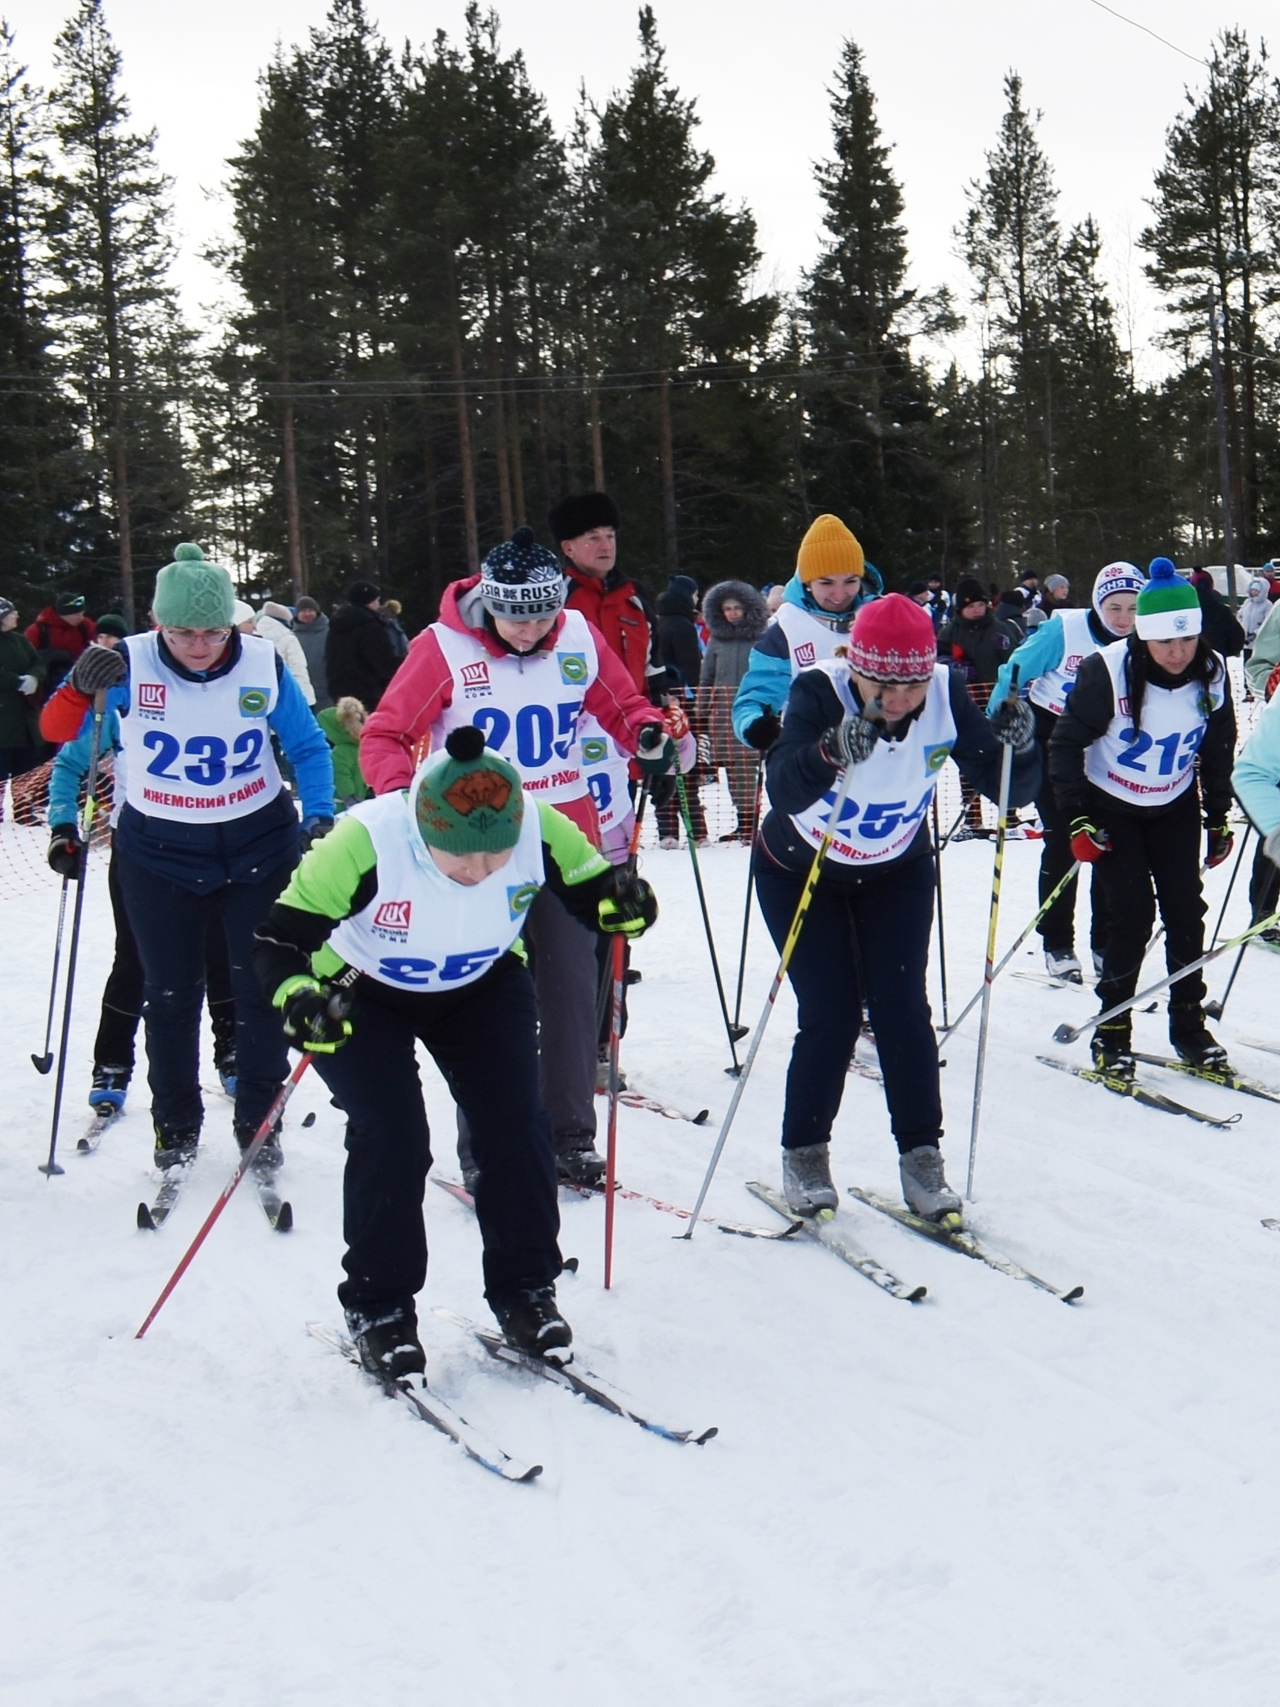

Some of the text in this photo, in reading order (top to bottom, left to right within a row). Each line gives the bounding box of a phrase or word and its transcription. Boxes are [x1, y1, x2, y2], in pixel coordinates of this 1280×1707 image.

[460, 661, 489, 686] LUK
[139, 684, 166, 709] LUK
[473, 700, 582, 768] 205
[1117, 725, 1206, 776] 213
[143, 728, 263, 786] 232
[143, 776, 266, 809] ИЖЕМСКИЙ РАЙОН
[374, 901, 411, 928] LUK
